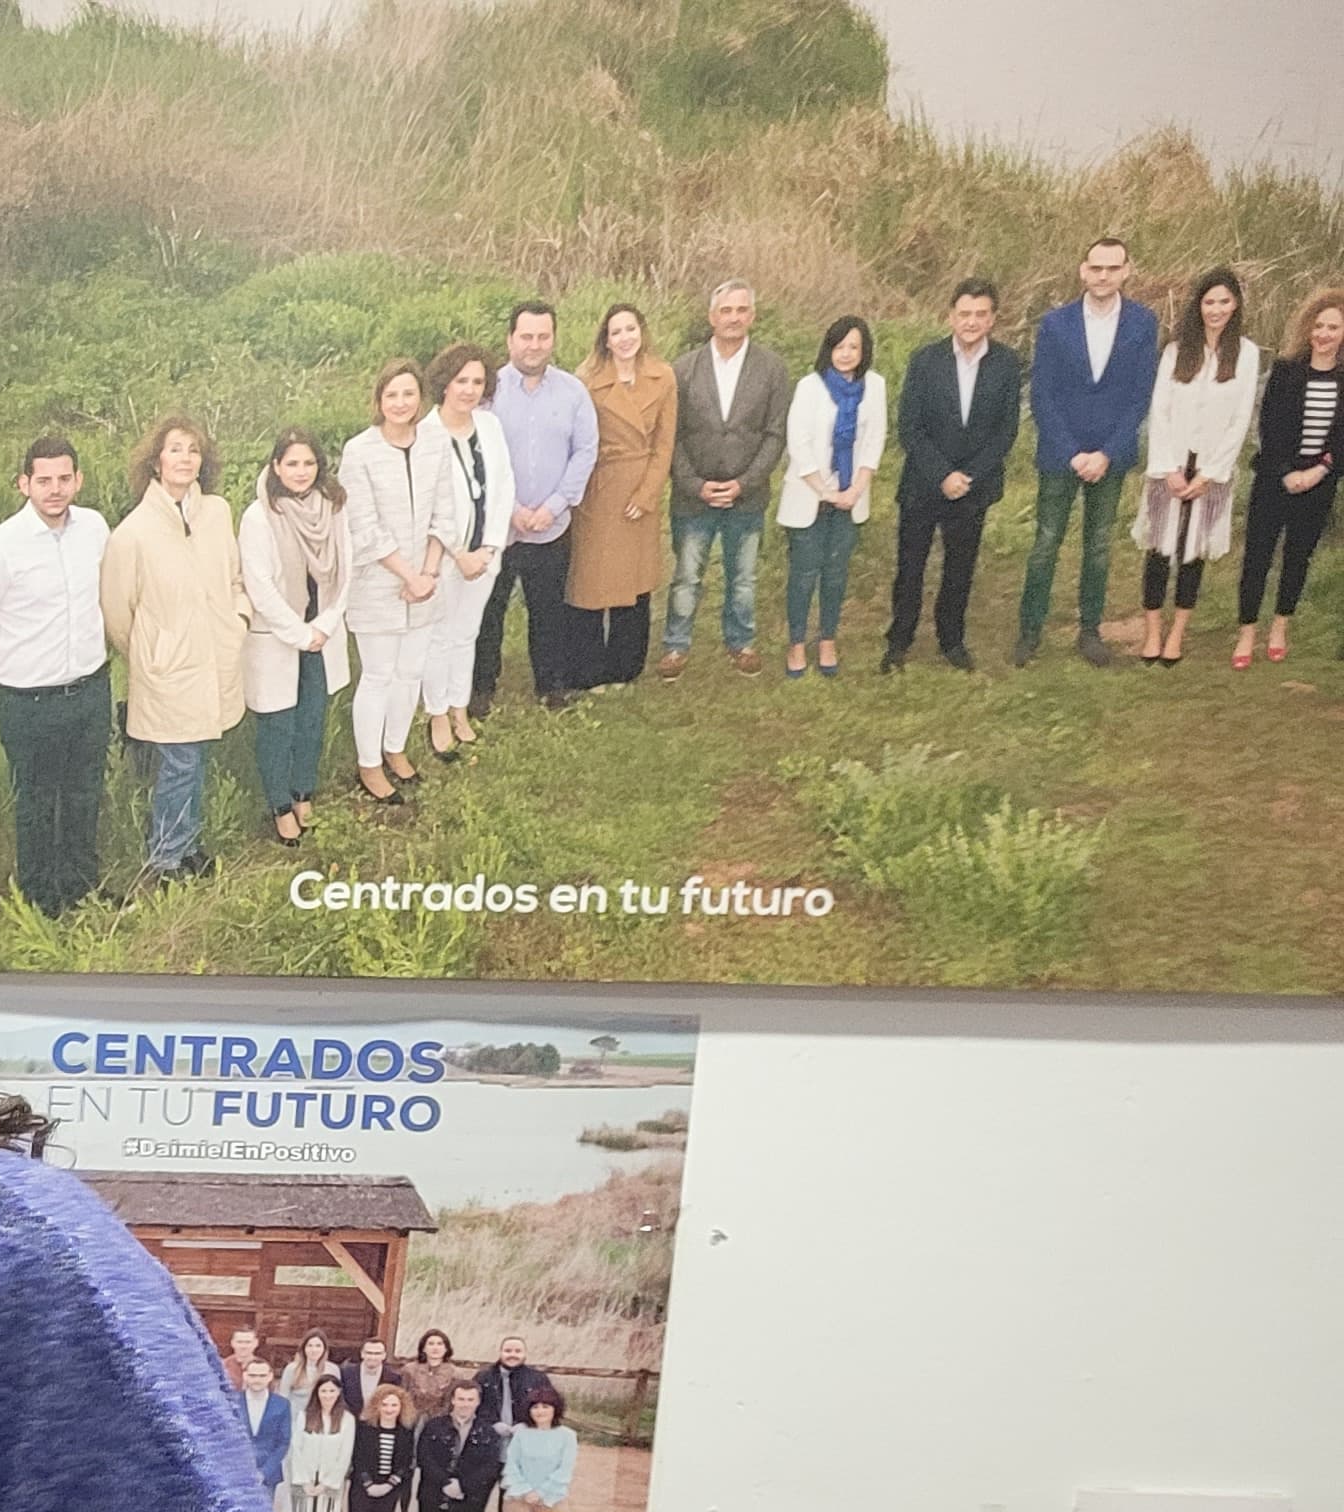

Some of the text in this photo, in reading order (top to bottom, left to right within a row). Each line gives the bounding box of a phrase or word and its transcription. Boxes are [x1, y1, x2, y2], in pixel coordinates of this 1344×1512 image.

[290, 870, 835, 917] Centrados en tu futuro
[51, 1031, 447, 1084] CENTRADOS
[47, 1085, 442, 1132] EN TU FUTURO
[123, 1138, 356, 1164] #DaimielEnPositivo
